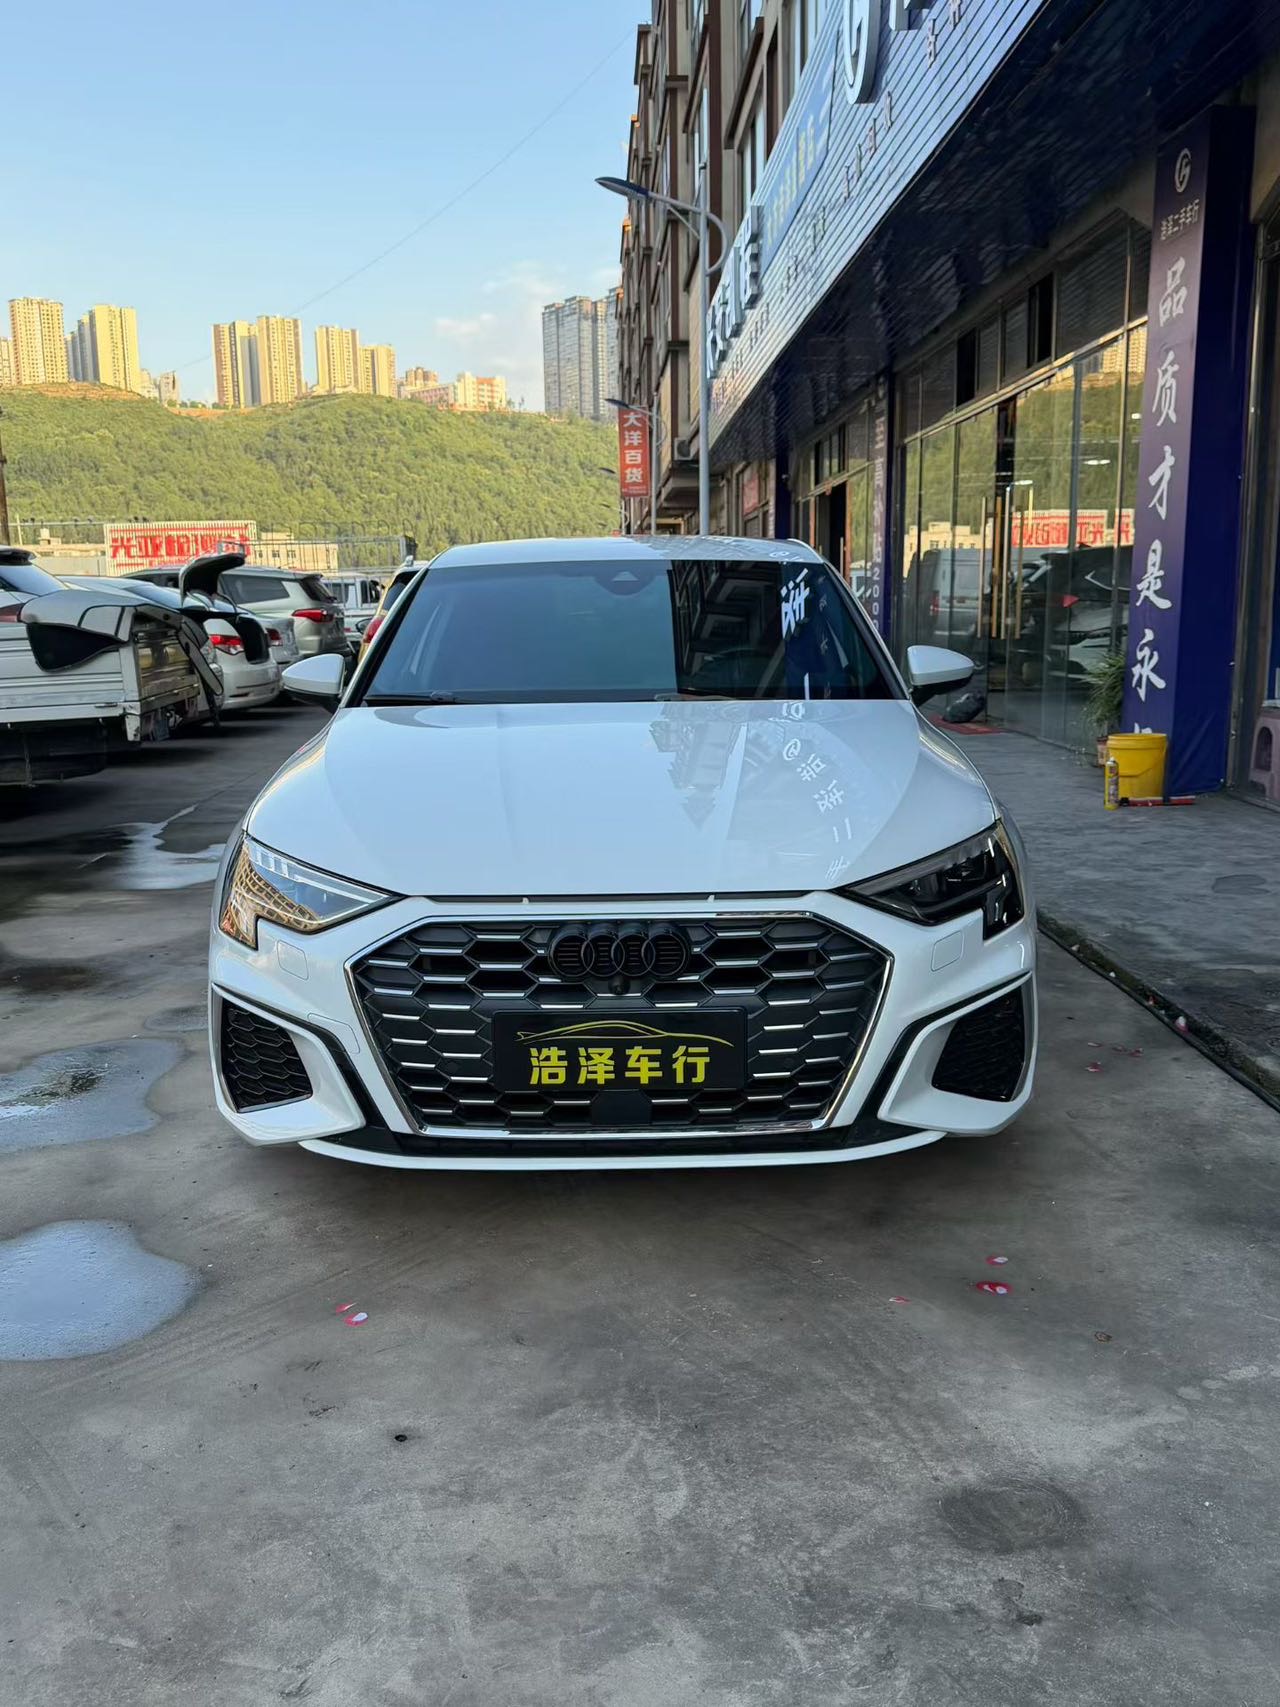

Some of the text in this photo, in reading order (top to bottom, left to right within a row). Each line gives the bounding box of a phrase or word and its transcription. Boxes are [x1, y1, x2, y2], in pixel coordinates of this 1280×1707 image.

[623, 412, 643, 483] 大洋百货
[1131, 256, 1187, 734] 品质才是永
[529, 1045, 710, 1085] 浩泽车行
